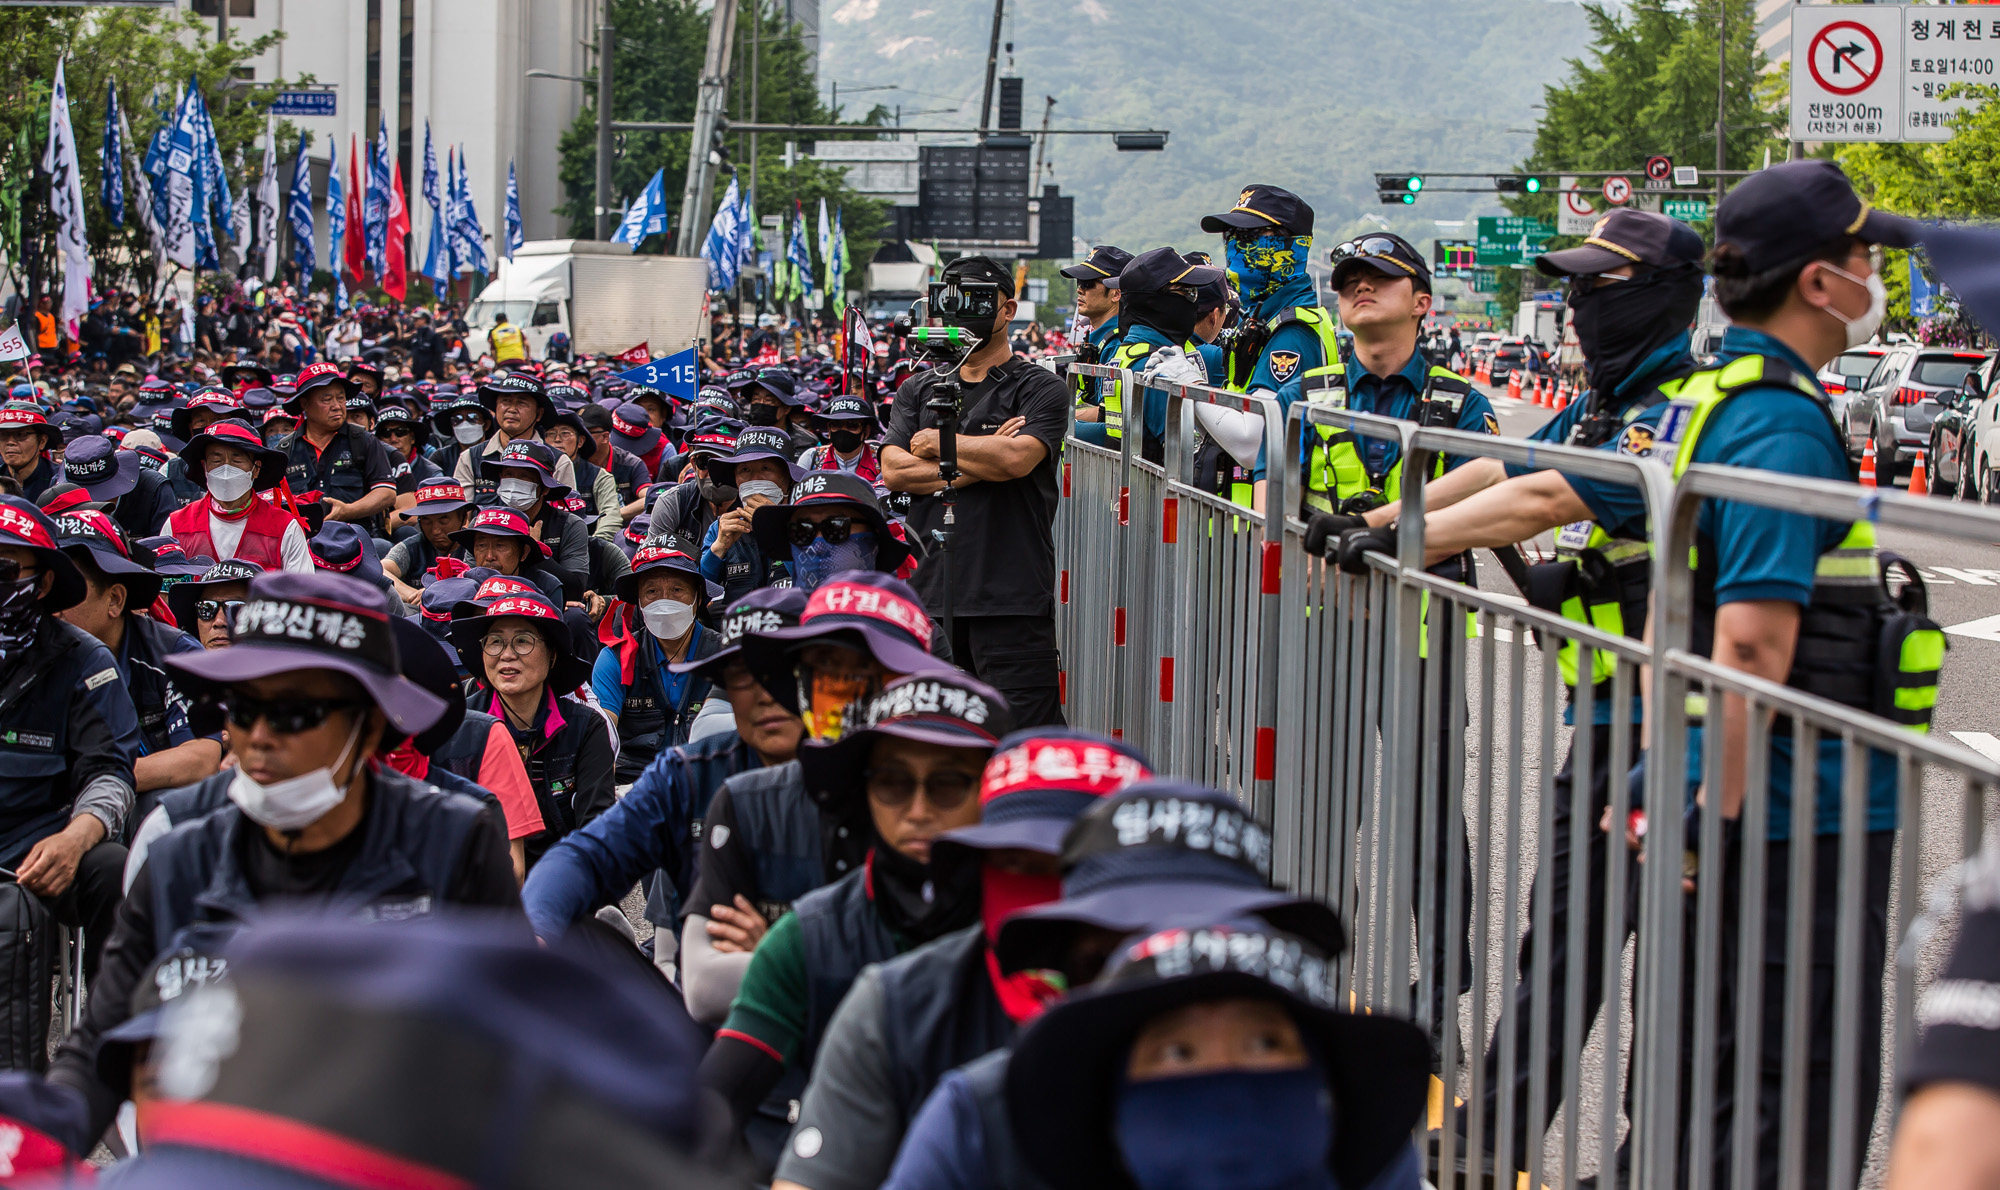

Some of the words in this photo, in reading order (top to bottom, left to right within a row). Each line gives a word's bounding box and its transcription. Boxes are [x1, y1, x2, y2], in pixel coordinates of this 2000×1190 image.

[1910, 58, 1993, 75] 토요일14:00
[1808, 102, 1882, 119] 전방300m
[1807, 121, 1847, 134] (자전거
[1853, 121, 1881, 134] 허용)
[623, 349, 647, 361] 4-03
[645, 365, 694, 384] 3-15
[0, 508, 35, 537] 투쟁
[486, 511, 511, 526] 투쟁
[825, 586, 880, 613] 단결
[517, 600, 547, 617] 투쟁
